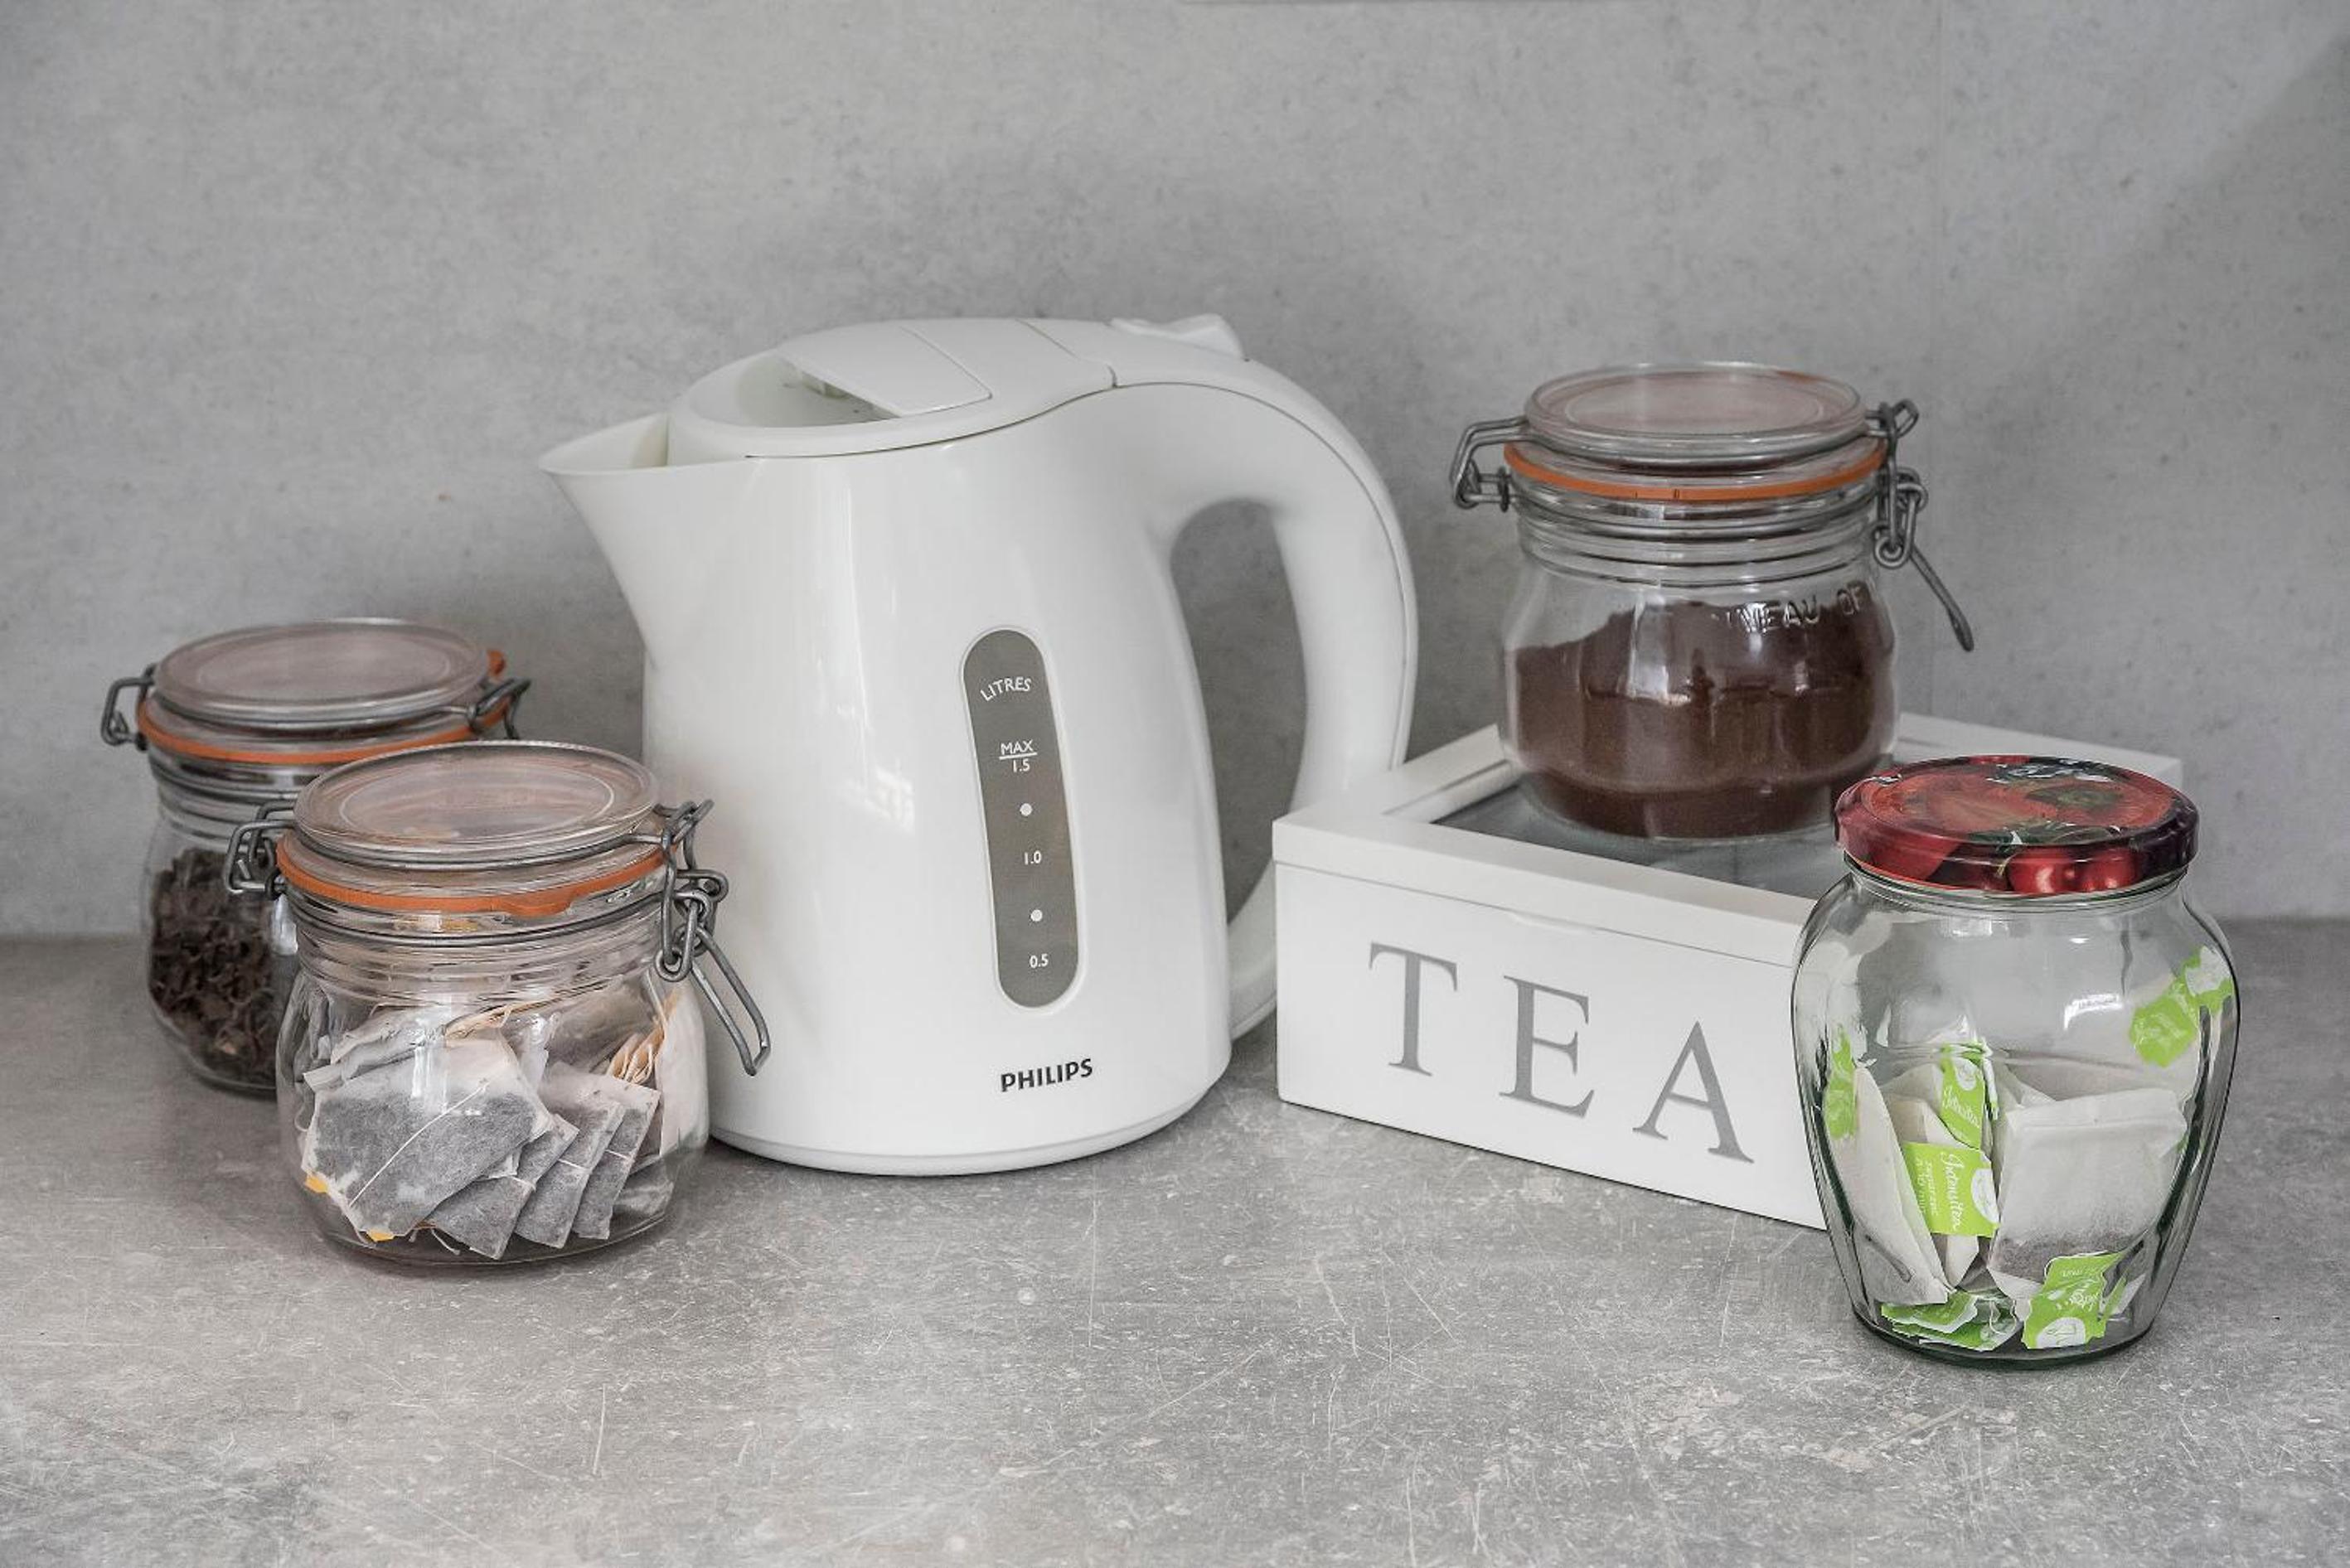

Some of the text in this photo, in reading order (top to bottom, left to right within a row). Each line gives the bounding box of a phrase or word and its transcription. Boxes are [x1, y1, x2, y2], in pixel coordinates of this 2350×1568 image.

[980, 676, 1032, 702] LITRES
[1001, 739, 1034, 755] MAX
[1013, 758, 1030, 772] 1.5
[1024, 849, 1042, 865] 1.0
[1029, 953, 1049, 969] 0.5
[1369, 941, 1755, 1164] TEA
[1001, 1057, 1093, 1092] PHILIPS
